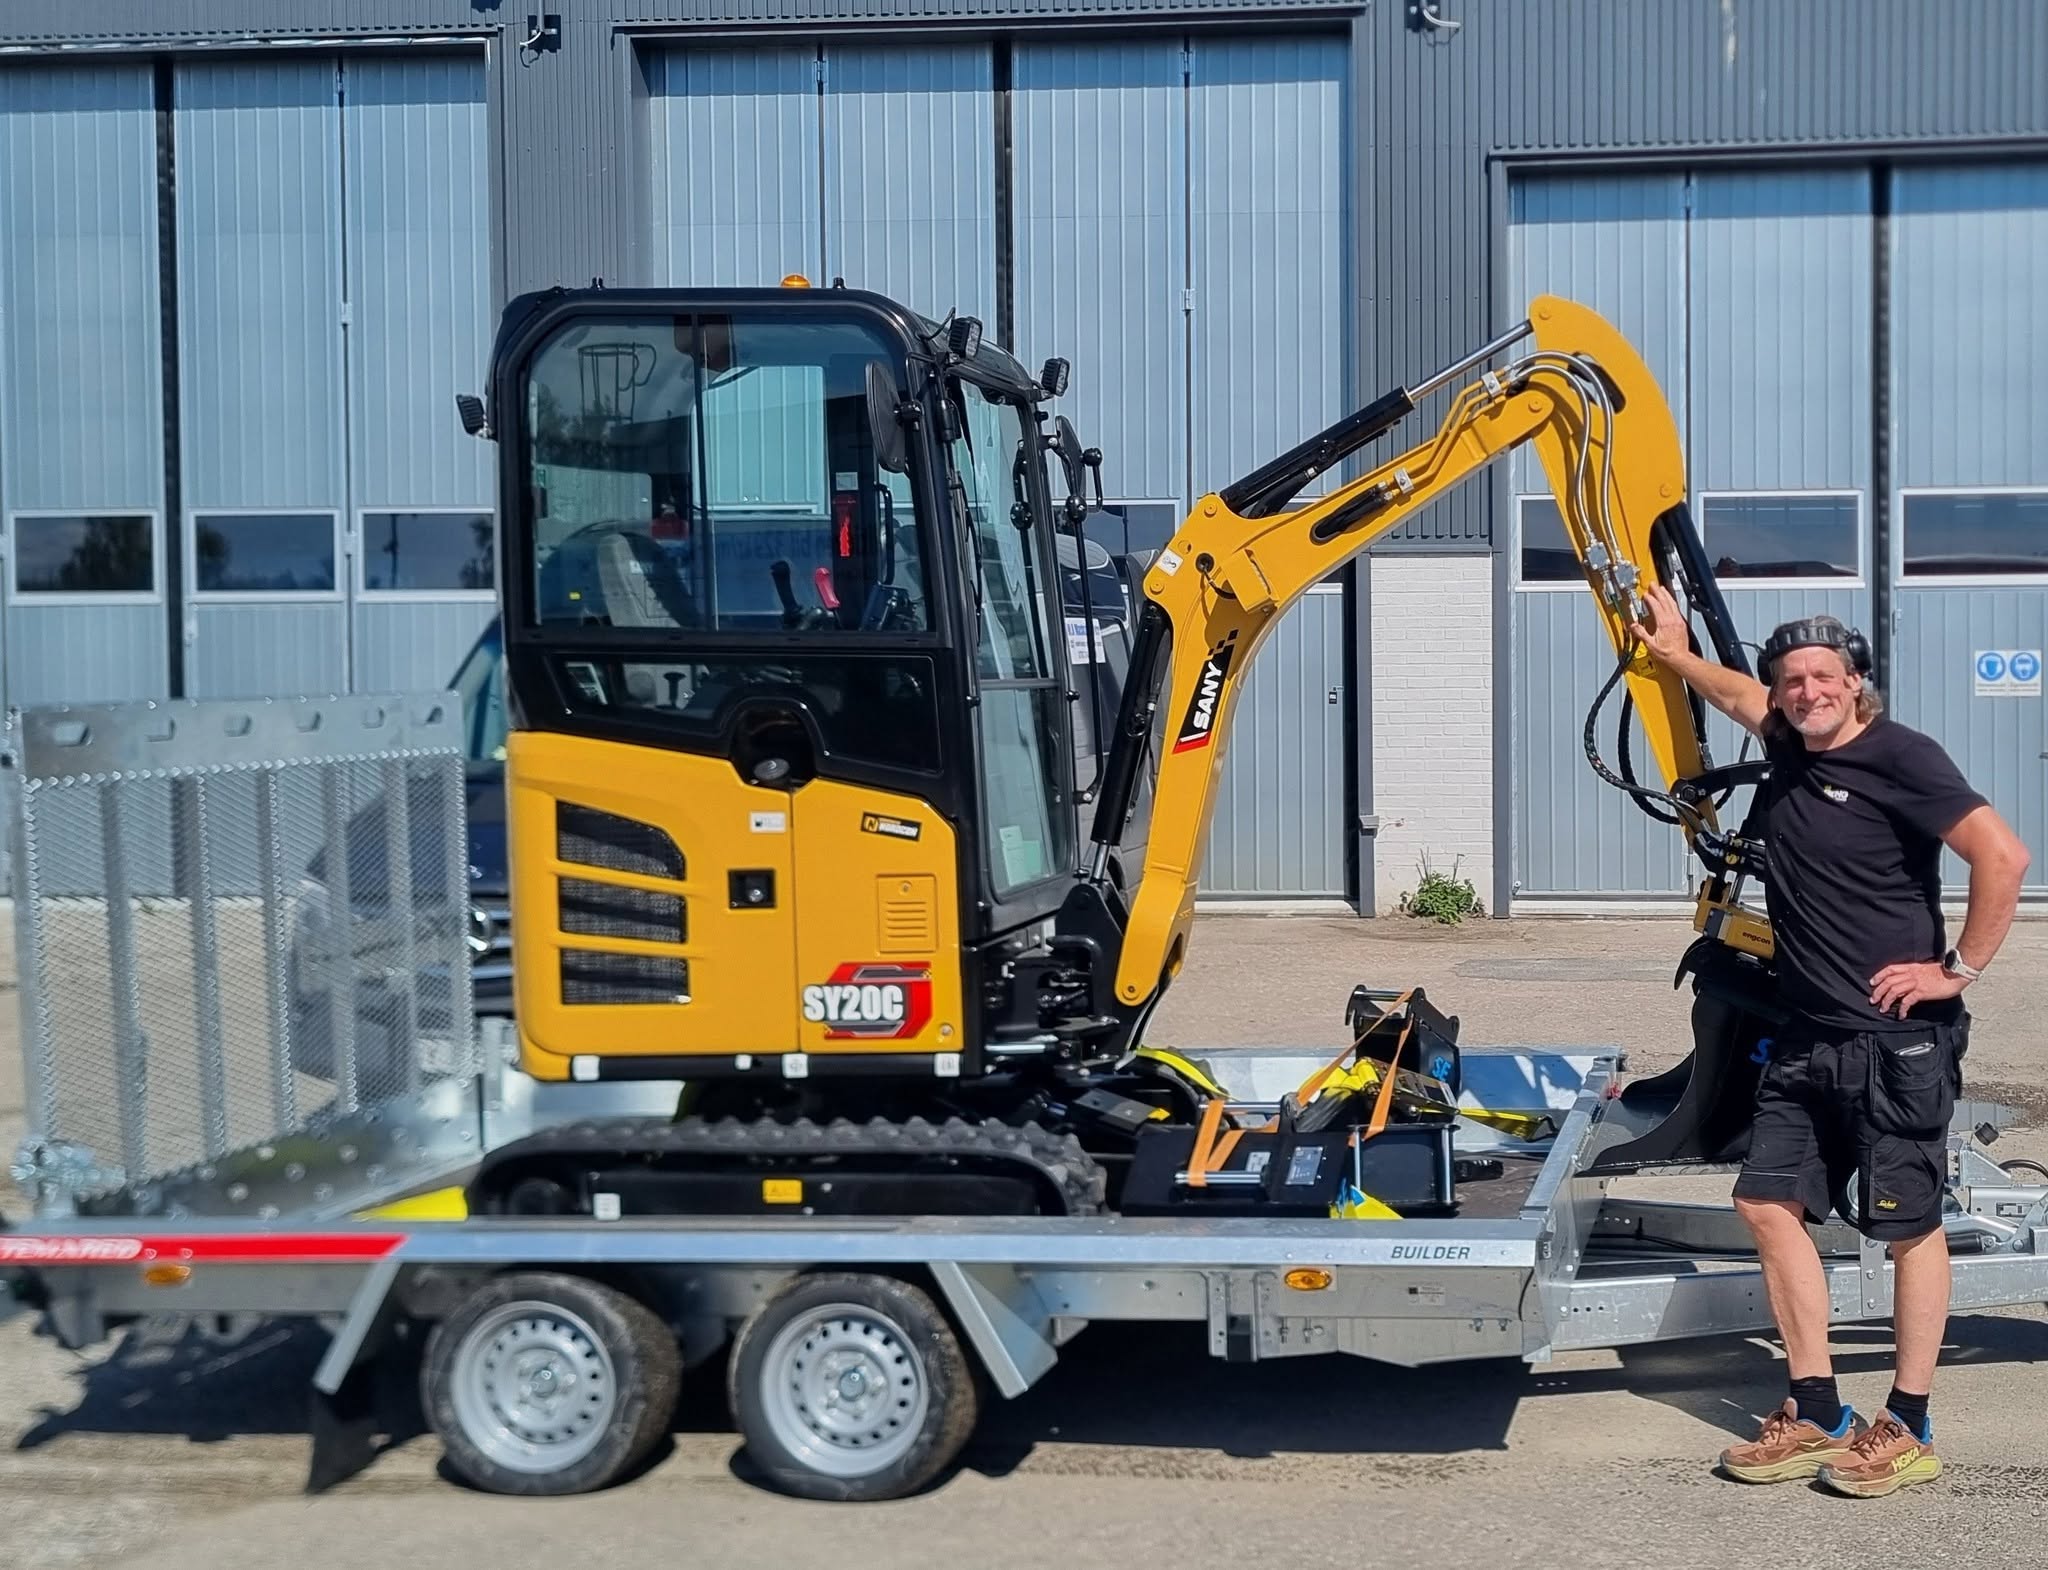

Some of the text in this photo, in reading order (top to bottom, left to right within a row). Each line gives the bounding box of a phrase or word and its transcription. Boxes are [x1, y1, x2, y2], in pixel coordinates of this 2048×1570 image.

[1193, 661, 1222, 730] SANY
[1742, 932, 1771, 945] engcon
[803, 985, 904, 1021] SY20C
[1391, 1246, 1471, 1260] BUILDER
[1891, 1446, 1920, 1473] HOKA
